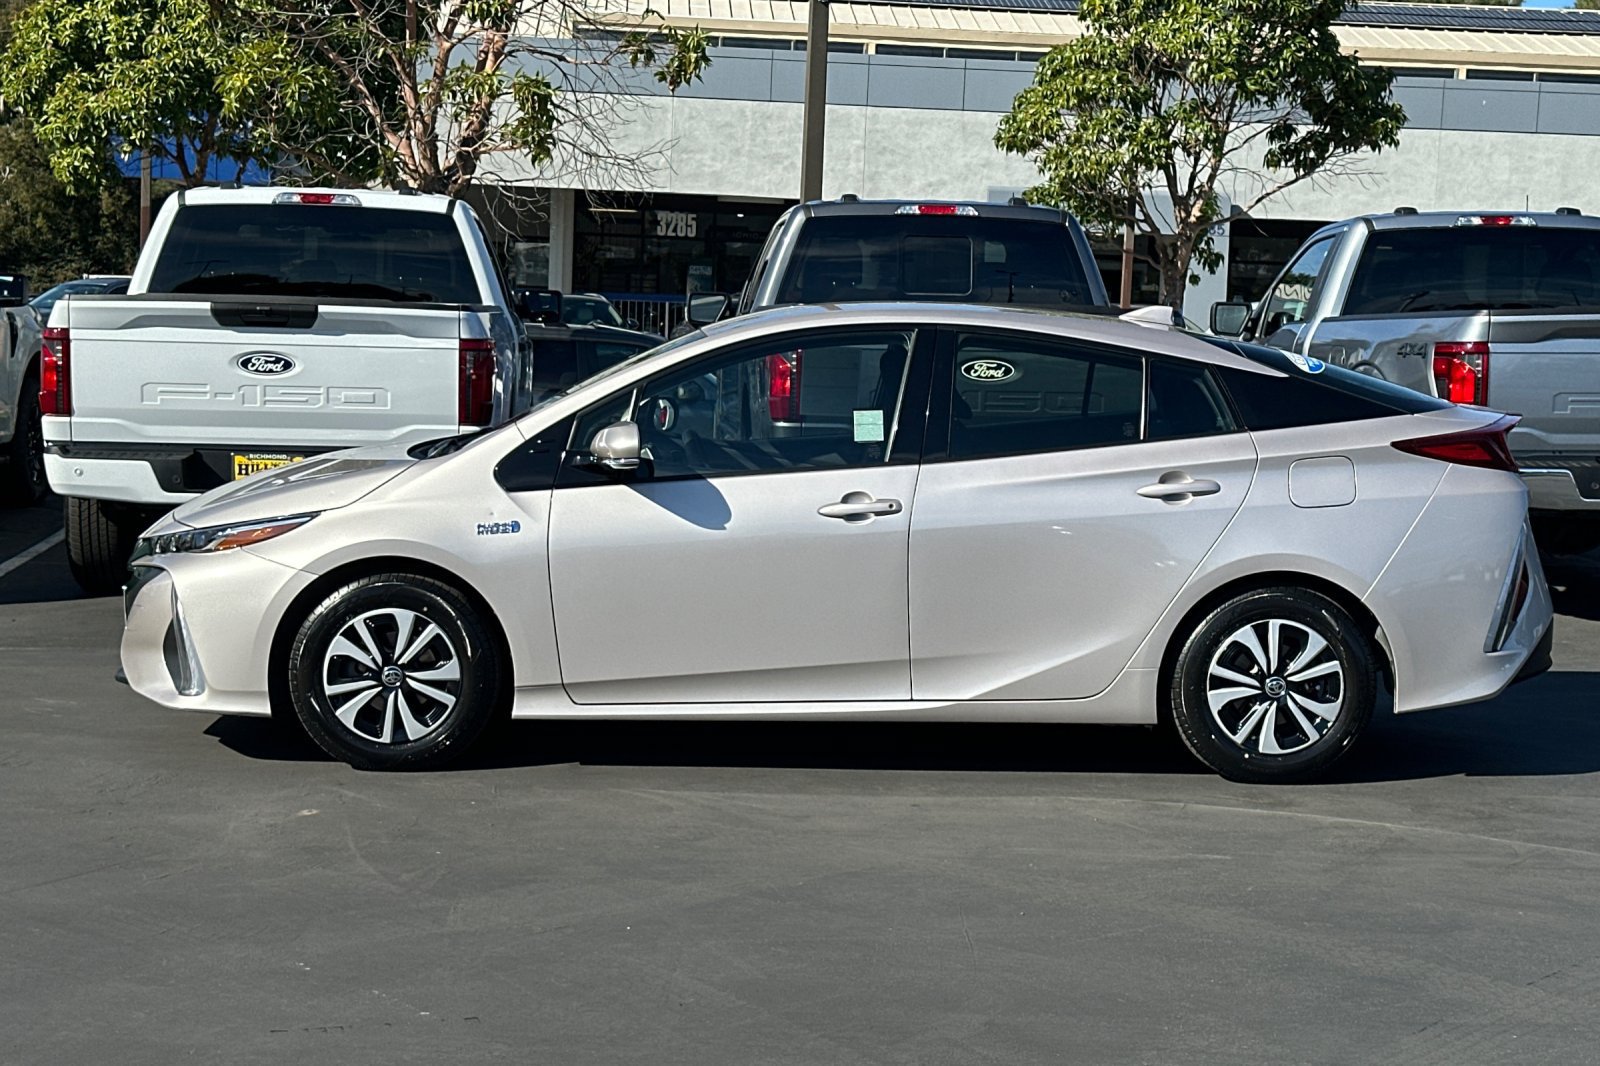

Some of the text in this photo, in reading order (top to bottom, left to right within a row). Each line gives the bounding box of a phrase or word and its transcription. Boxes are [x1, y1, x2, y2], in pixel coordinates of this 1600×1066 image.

[656, 212, 697, 237] 3285
[247, 356, 284, 371] Ford
[971, 362, 1005, 377] Ford
[141, 382, 391, 409] F-150
[962, 390, 1105, 413] 150
[237, 464, 279, 475] HILL
